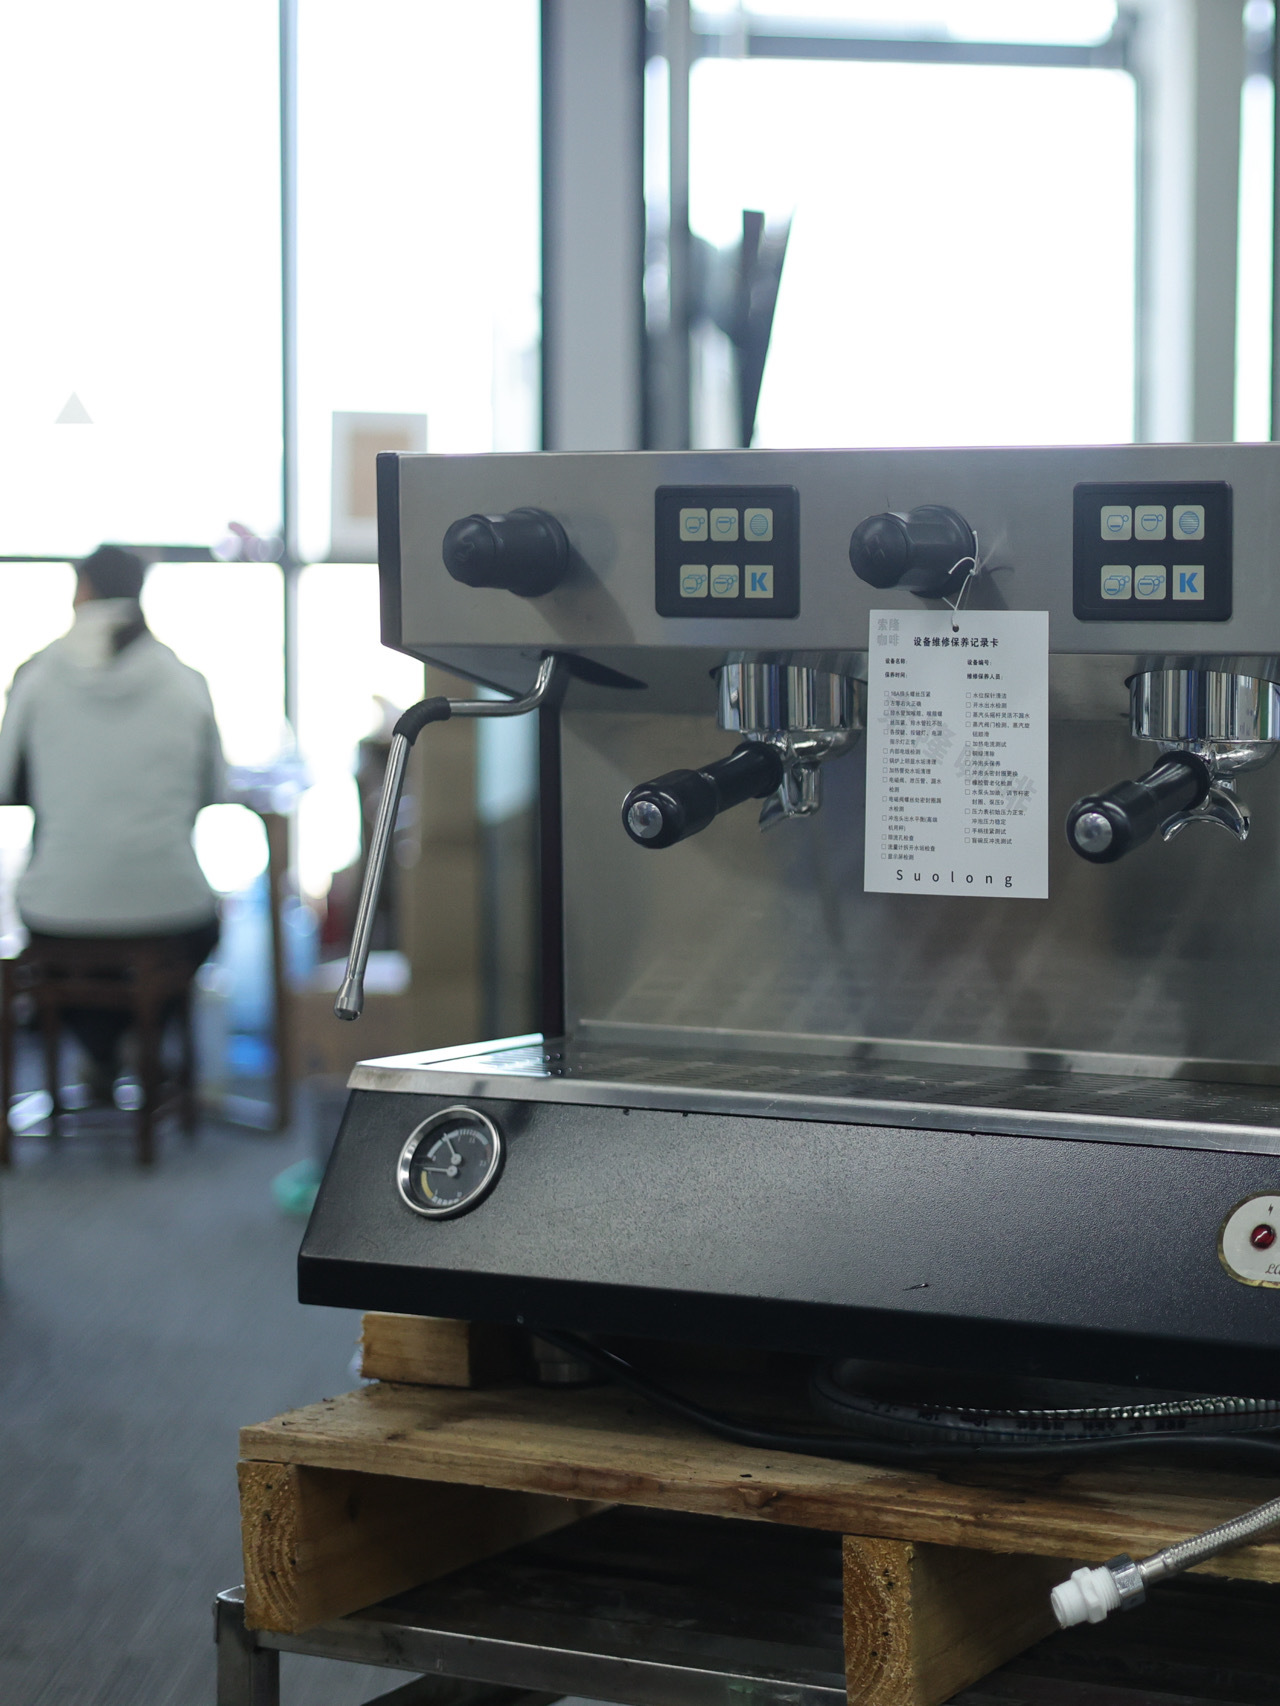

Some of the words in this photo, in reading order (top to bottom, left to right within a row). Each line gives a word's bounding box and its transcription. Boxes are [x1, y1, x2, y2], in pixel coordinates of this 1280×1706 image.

[751, 572, 768, 592] K
[1179, 572, 1198, 593] K
[877, 618, 900, 632] 索隆
[877, 634, 900, 647] 咖啡
[914, 637, 999, 648] 设备维修保养记录卡
[897, 870, 1012, 888] Suolong
